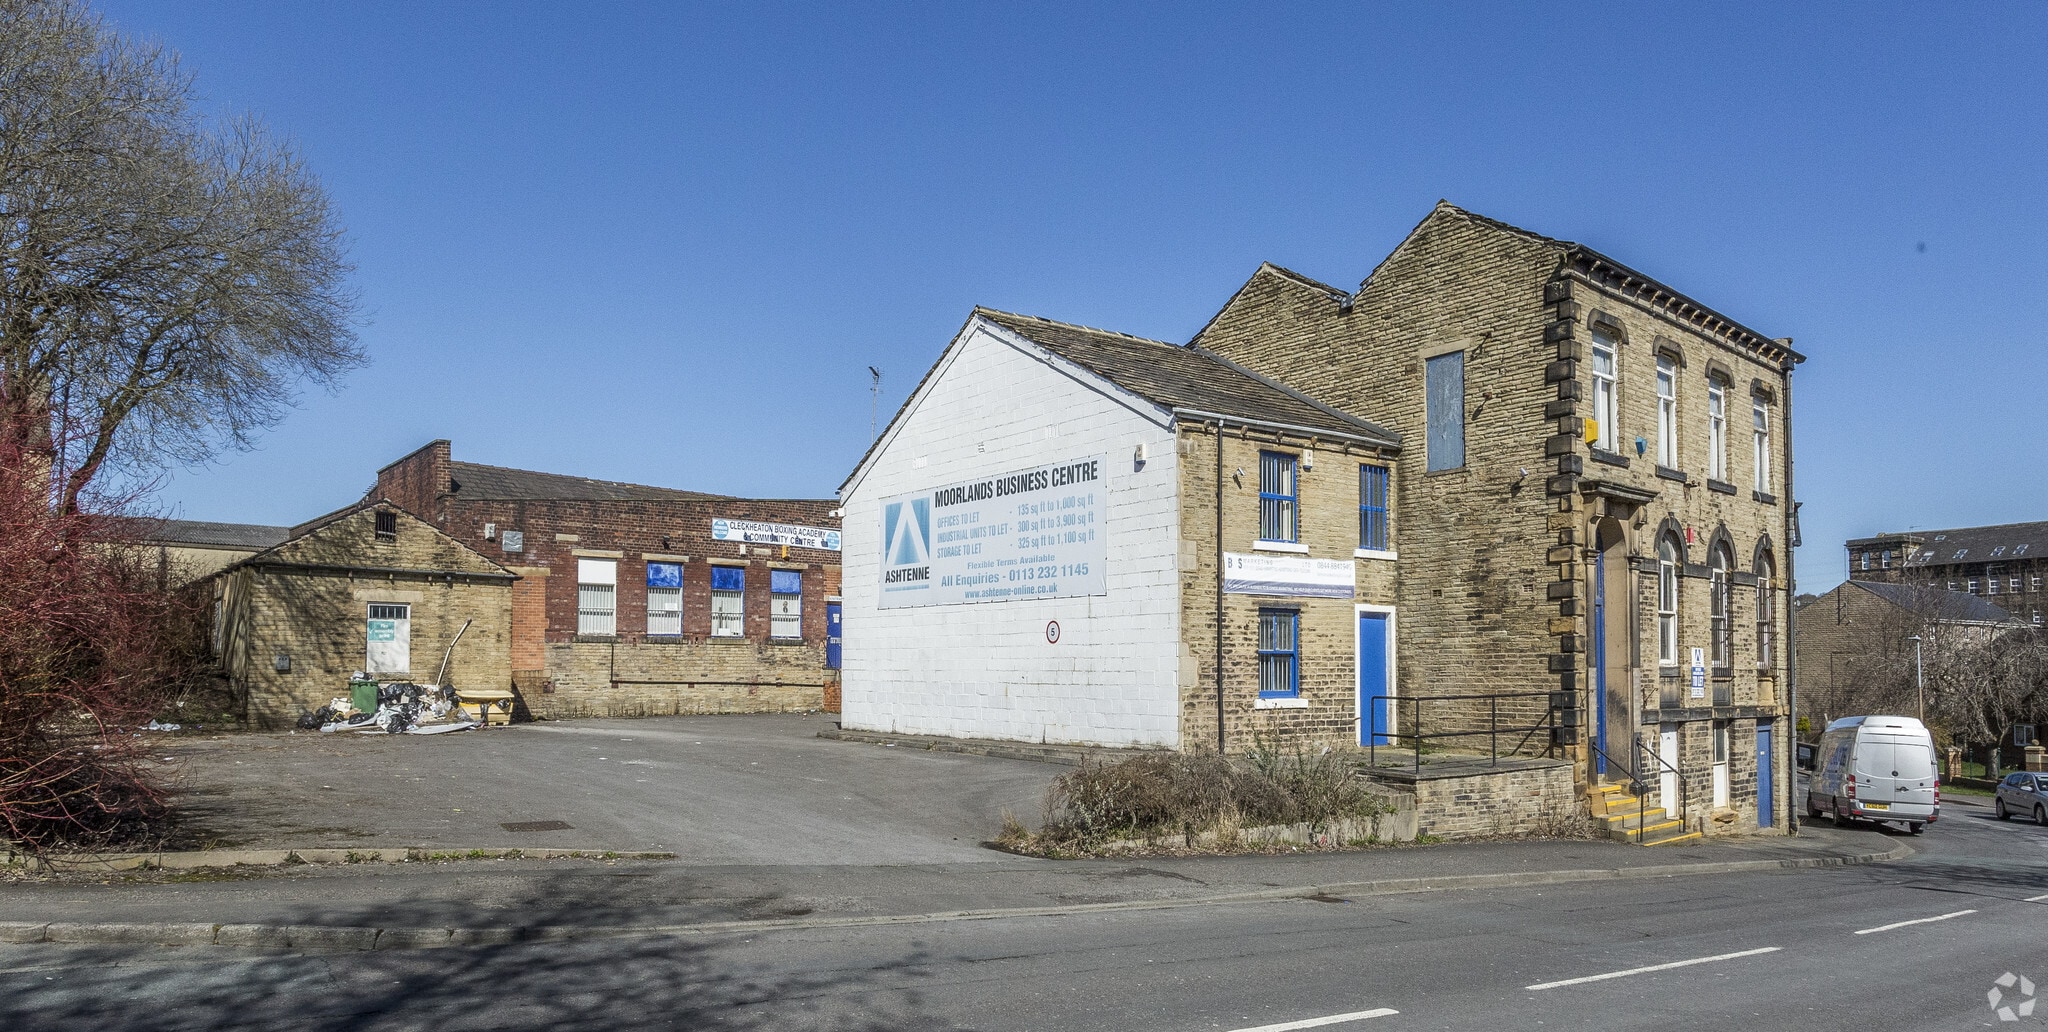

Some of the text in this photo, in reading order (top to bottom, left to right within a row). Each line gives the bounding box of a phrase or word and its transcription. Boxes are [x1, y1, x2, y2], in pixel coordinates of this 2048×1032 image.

[934, 460, 1098, 508] MOORLANDS BUSINESS CENTRE
[937, 514, 960, 529] OFFICES
[961, 513, 969, 525] TO
[969, 511, 980, 523] LET
[1017, 503, 1029, 516] 135
[1030, 504, 1039, 516] sq
[1040, 501, 1046, 513] ft
[1047, 500, 1054, 512] to
[1056, 495, 1076, 511] 1,000
[1077, 496, 1086, 509] sq
[1087, 493, 1094, 505] ft
[729, 521, 826, 538] CLECKHEATON BOXING ACADEMY
[937, 529, 969, 544] INDUSTRIAL
[969, 526, 987, 539] UNITS
[988, 524, 996, 537] TO
[997, 522, 1009, 536] LET
[1017, 520, 1029, 533] 300
[1030, 521, 1039, 533] sq
[1040, 518, 1046, 530] ft
[1047, 517, 1055, 529] to
[1056, 513, 1076, 529] 3,900
[1077, 514, 1086, 527] sq
[1088, 510, 1094, 523] ft
[750, 533, 788, 544] COMMUNITY
[790, 536, 815, 547] CENTRE
[937, 545, 962, 559] STORAGE
[963, 543, 971, 556] TO
[971, 542, 982, 555] LET
[1017, 536, 1030, 549] 325
[1031, 538, 1039, 550] sq
[1040, 534, 1046, 546] ft
[1048, 534, 1055, 546] to
[1057, 530, 1077, 546] 1,100
[1078, 532, 1087, 544] sq
[1088, 528, 1095, 541] ft
[967, 553, 1056, 570] Flexible Terms Available
[884, 566, 930, 584] ASHTENNE
[941, 574, 953, 587] All
[955, 572, 1000, 587] Enquiries
[1009, 567, 1034, 582] 0113
[1037, 565, 1058, 580] 232
[1060, 562, 1089, 577] 1145
[964, 582, 1058, 599] www.ashtenne-online.co.uk
[1050, 627, 1055, 637] 5
